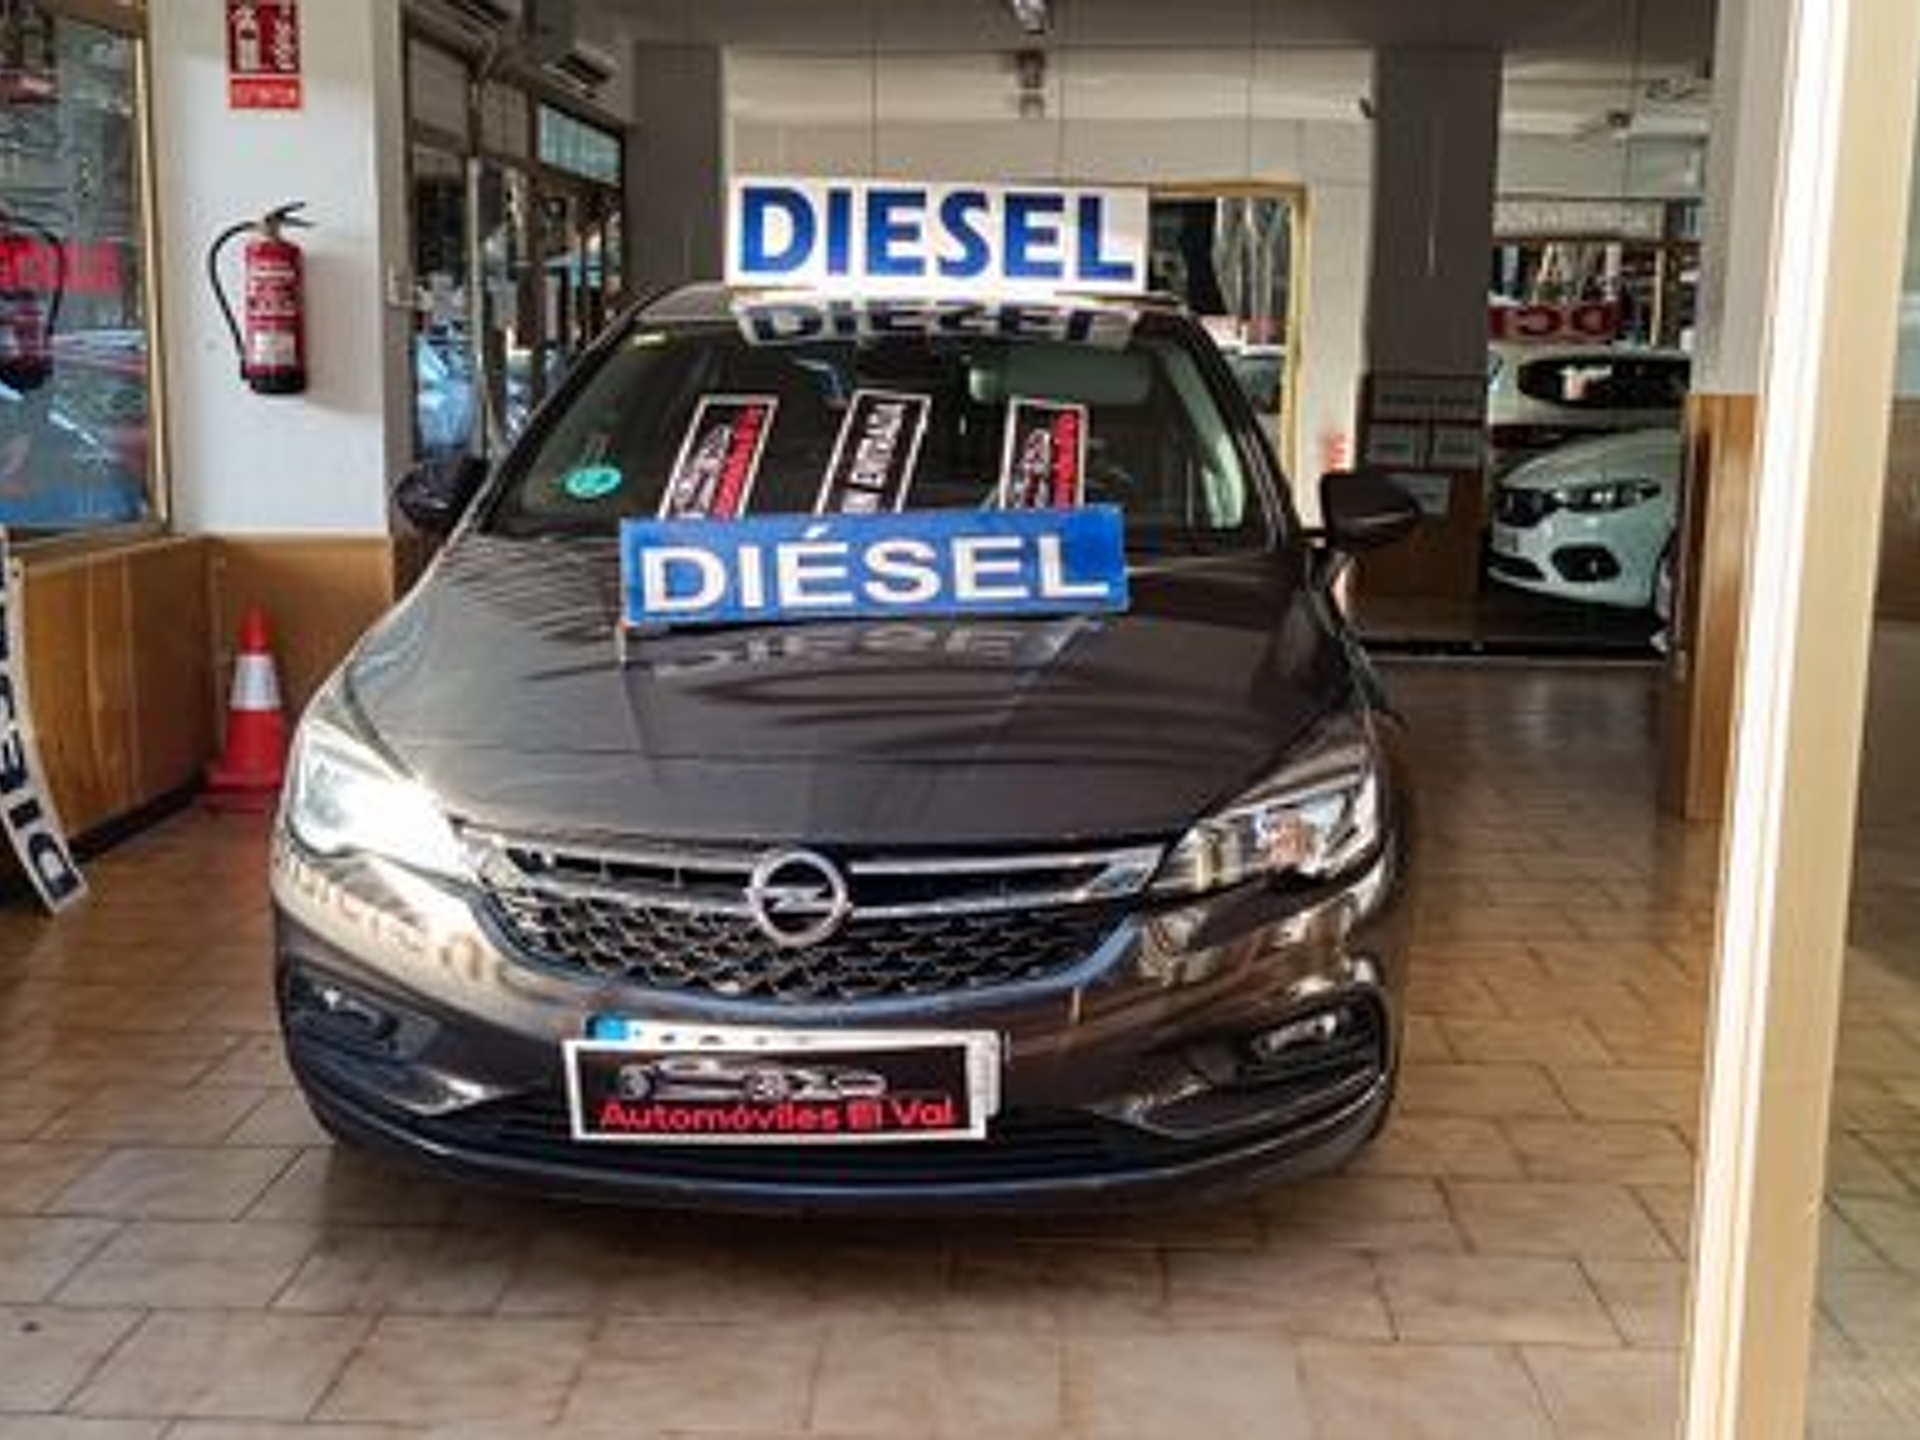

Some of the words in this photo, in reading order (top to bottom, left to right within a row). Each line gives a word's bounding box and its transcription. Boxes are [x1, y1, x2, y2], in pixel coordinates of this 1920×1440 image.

[741, 186, 1134, 281] DIESEL
[641, 526, 1110, 613] DIÉSEL
[599, 1100, 839, 1132] Automóviles
[890, 1095, 955, 1128] Val
